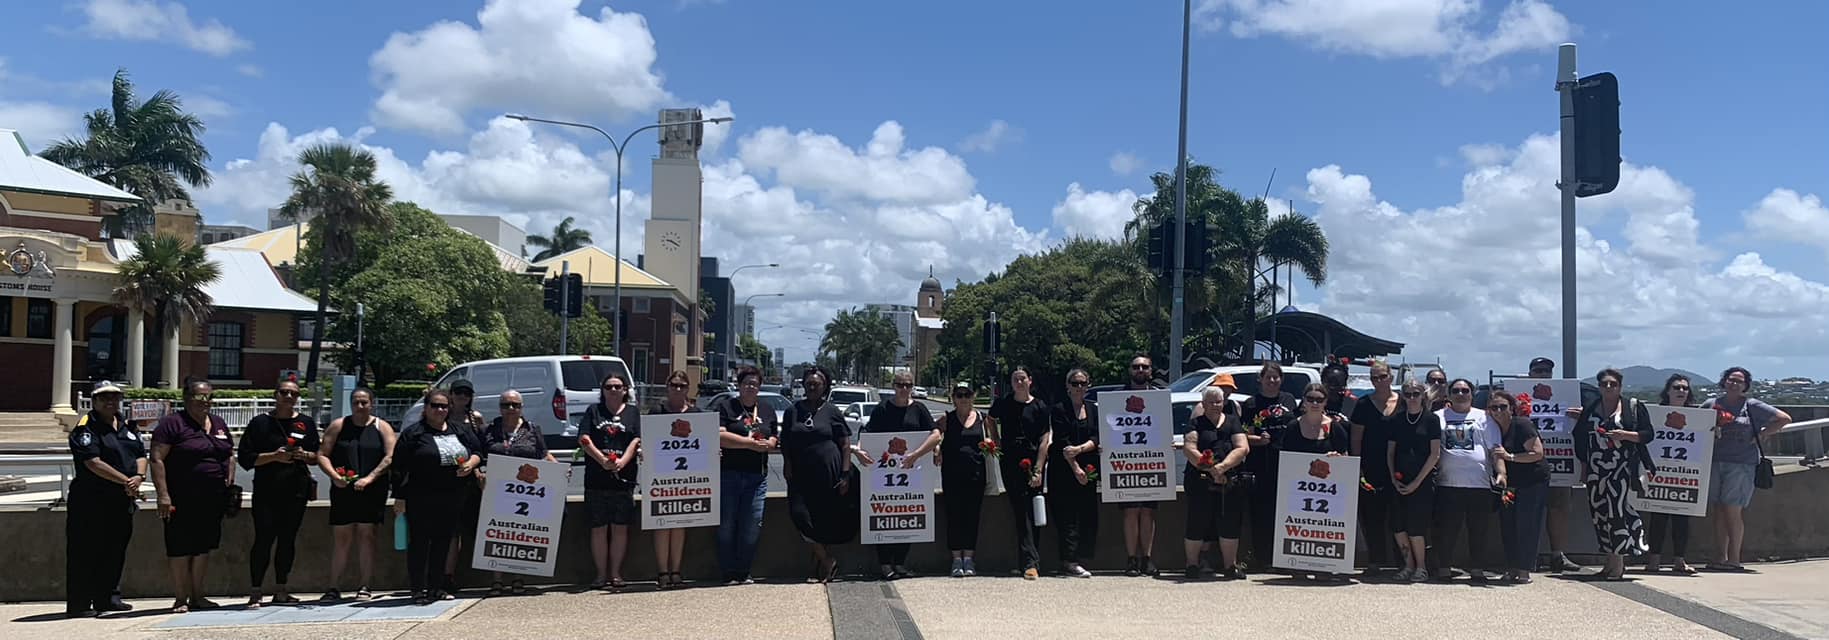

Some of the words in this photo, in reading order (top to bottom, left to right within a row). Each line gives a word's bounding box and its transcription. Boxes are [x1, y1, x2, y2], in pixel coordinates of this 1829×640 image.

[28, 284, 52, 292] HOUSE
[1532, 403, 1560, 414] 024
[1115, 415, 1152, 427] 2024
[1122, 431, 1147, 445] 12
[1543, 437, 1572, 445] ralian
[1656, 430, 1695, 443] 2024
[661, 438, 700, 450] 2024
[1109, 450, 1164, 459] Australian
[1543, 448, 1574, 456] men
[1660, 446, 1688, 460] 12
[674, 457, 688, 470] 2
[1110, 460, 1166, 472] Women
[1657, 465, 1699, 475] stralian
[651, 476, 710, 486] Australian
[884, 473, 909, 487] 12
[1116, 474, 1163, 487] killed.
[505, 483, 546, 498] 2024
[650, 487, 712, 498] Children
[1297, 481, 1337, 495] 2024
[1644, 487, 1694, 501] killed.
[870, 492, 924, 501] Australian
[514, 502, 529, 516] 2
[658, 500, 707, 514] killed.
[870, 502, 925, 514] Women
[1302, 498, 1329, 514] 12
[488, 518, 549, 532] Australian
[876, 516, 923, 529] killed.
[1285, 515, 1345, 528] Australian
[485, 528, 550, 545] Children
[1285, 524, 1345, 540] Women
[491, 543, 542, 560] killed.
[1290, 541, 1340, 557] killed.
